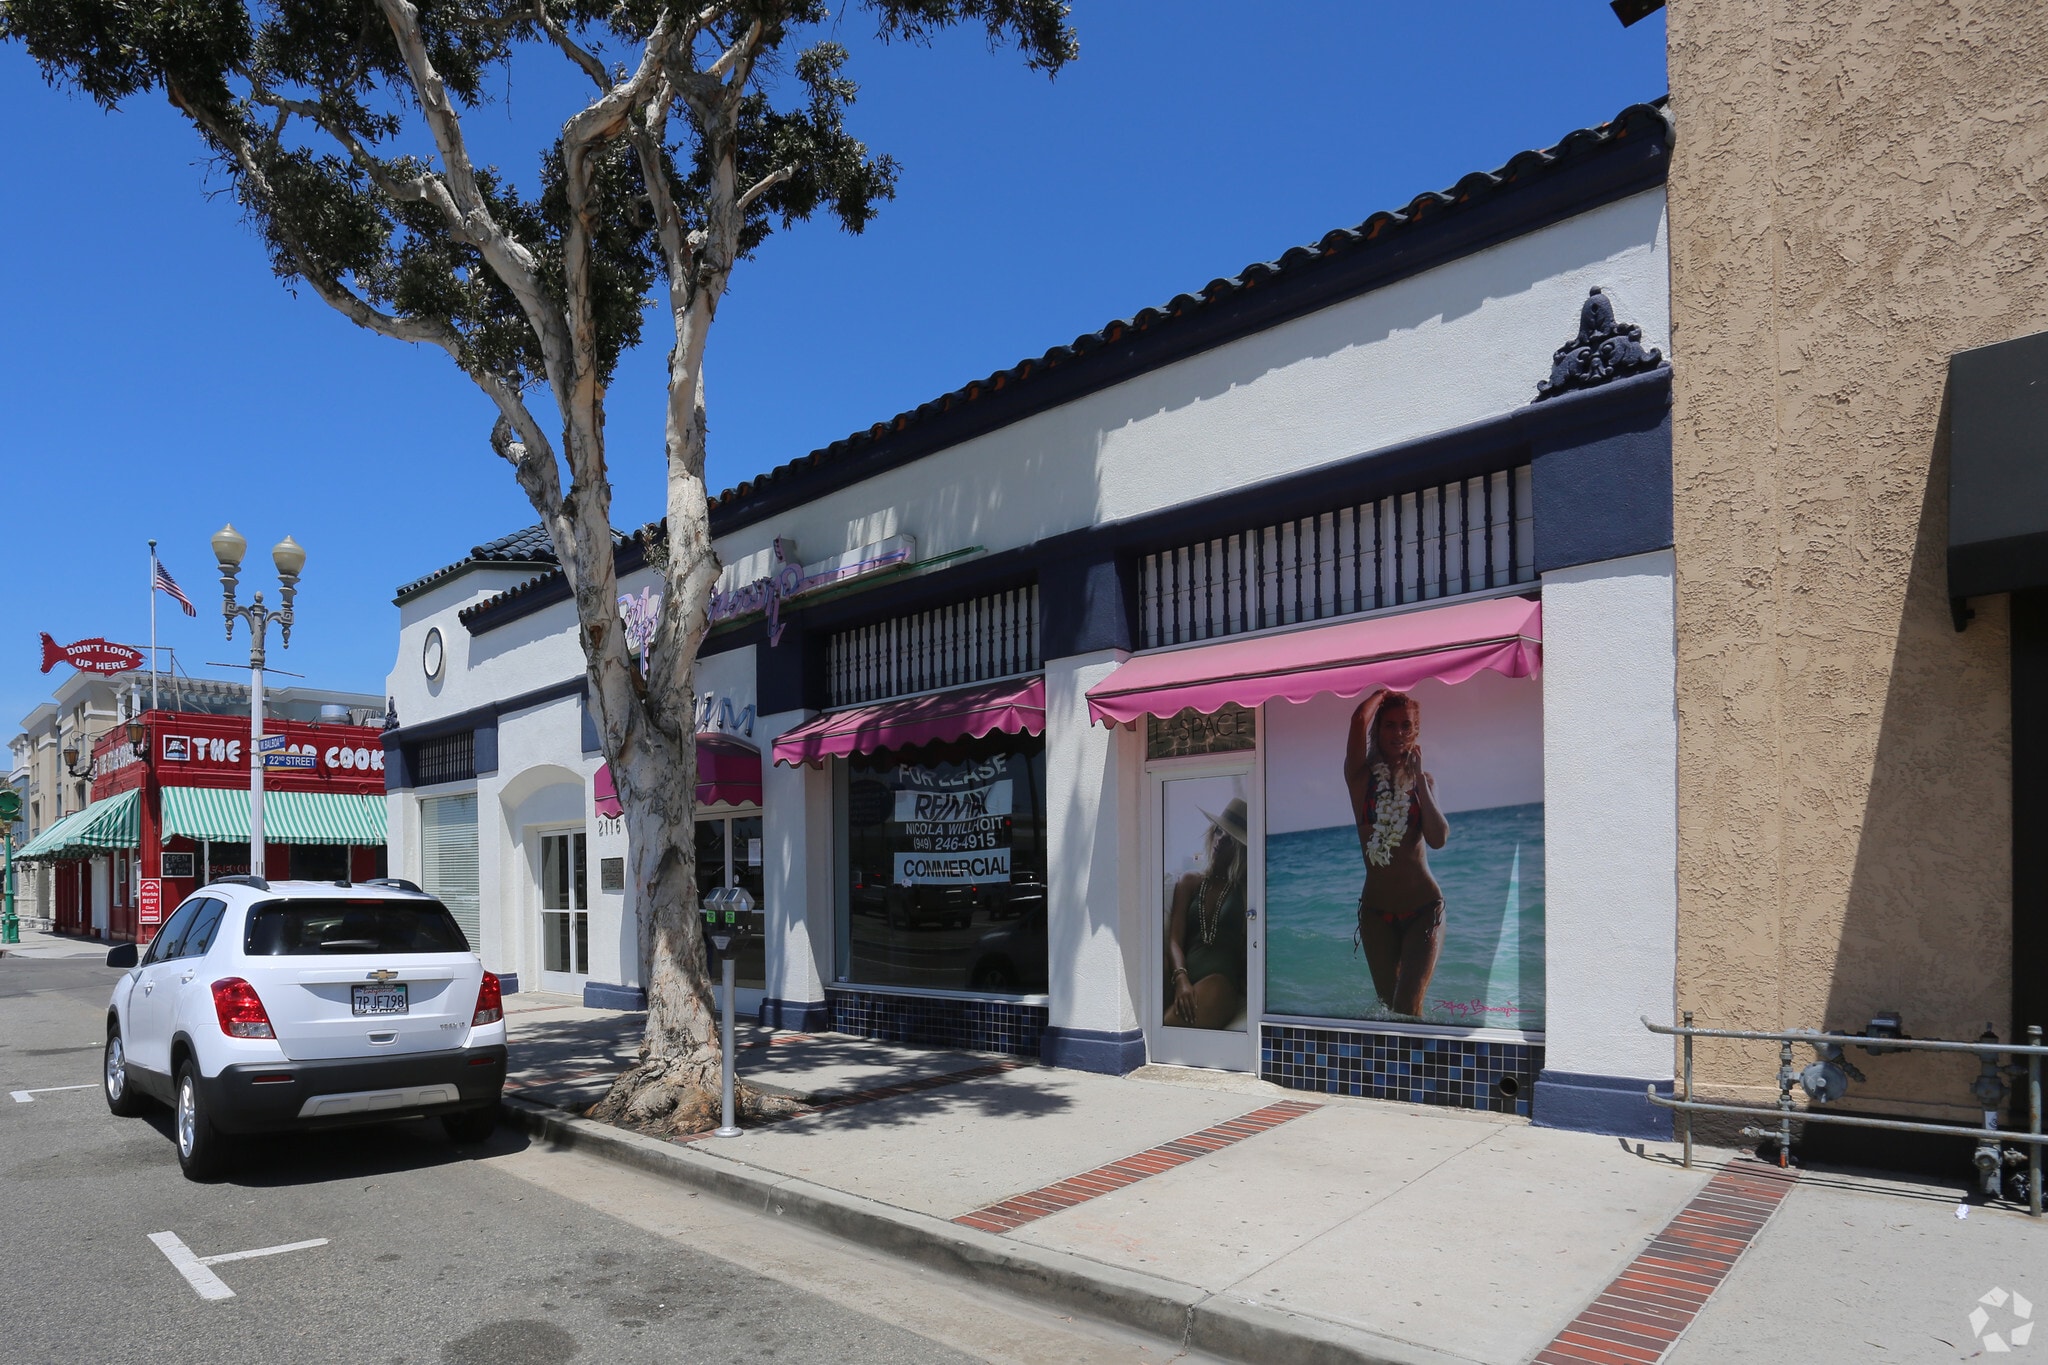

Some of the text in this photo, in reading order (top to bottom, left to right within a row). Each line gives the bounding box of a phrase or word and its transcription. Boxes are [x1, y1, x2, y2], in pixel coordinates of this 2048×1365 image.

[66, 644, 134, 659] DON'T LOOK
[75, 658, 128, 670] UP HERE
[192, 737, 240, 762] THE
[265, 738, 280, 749] BALBOA
[269, 755, 316, 766] 22ND STREET
[899, 763, 937, 786] FOR
[599, 818, 621, 837] 2116
[905, 816, 1004, 835] NICOLA WILLHOIT
[913, 832, 996, 850] (949) 246-4915
[903, 856, 1009, 878] COMMERCIAL
[356, 995, 405, 1009] 7PJF798
